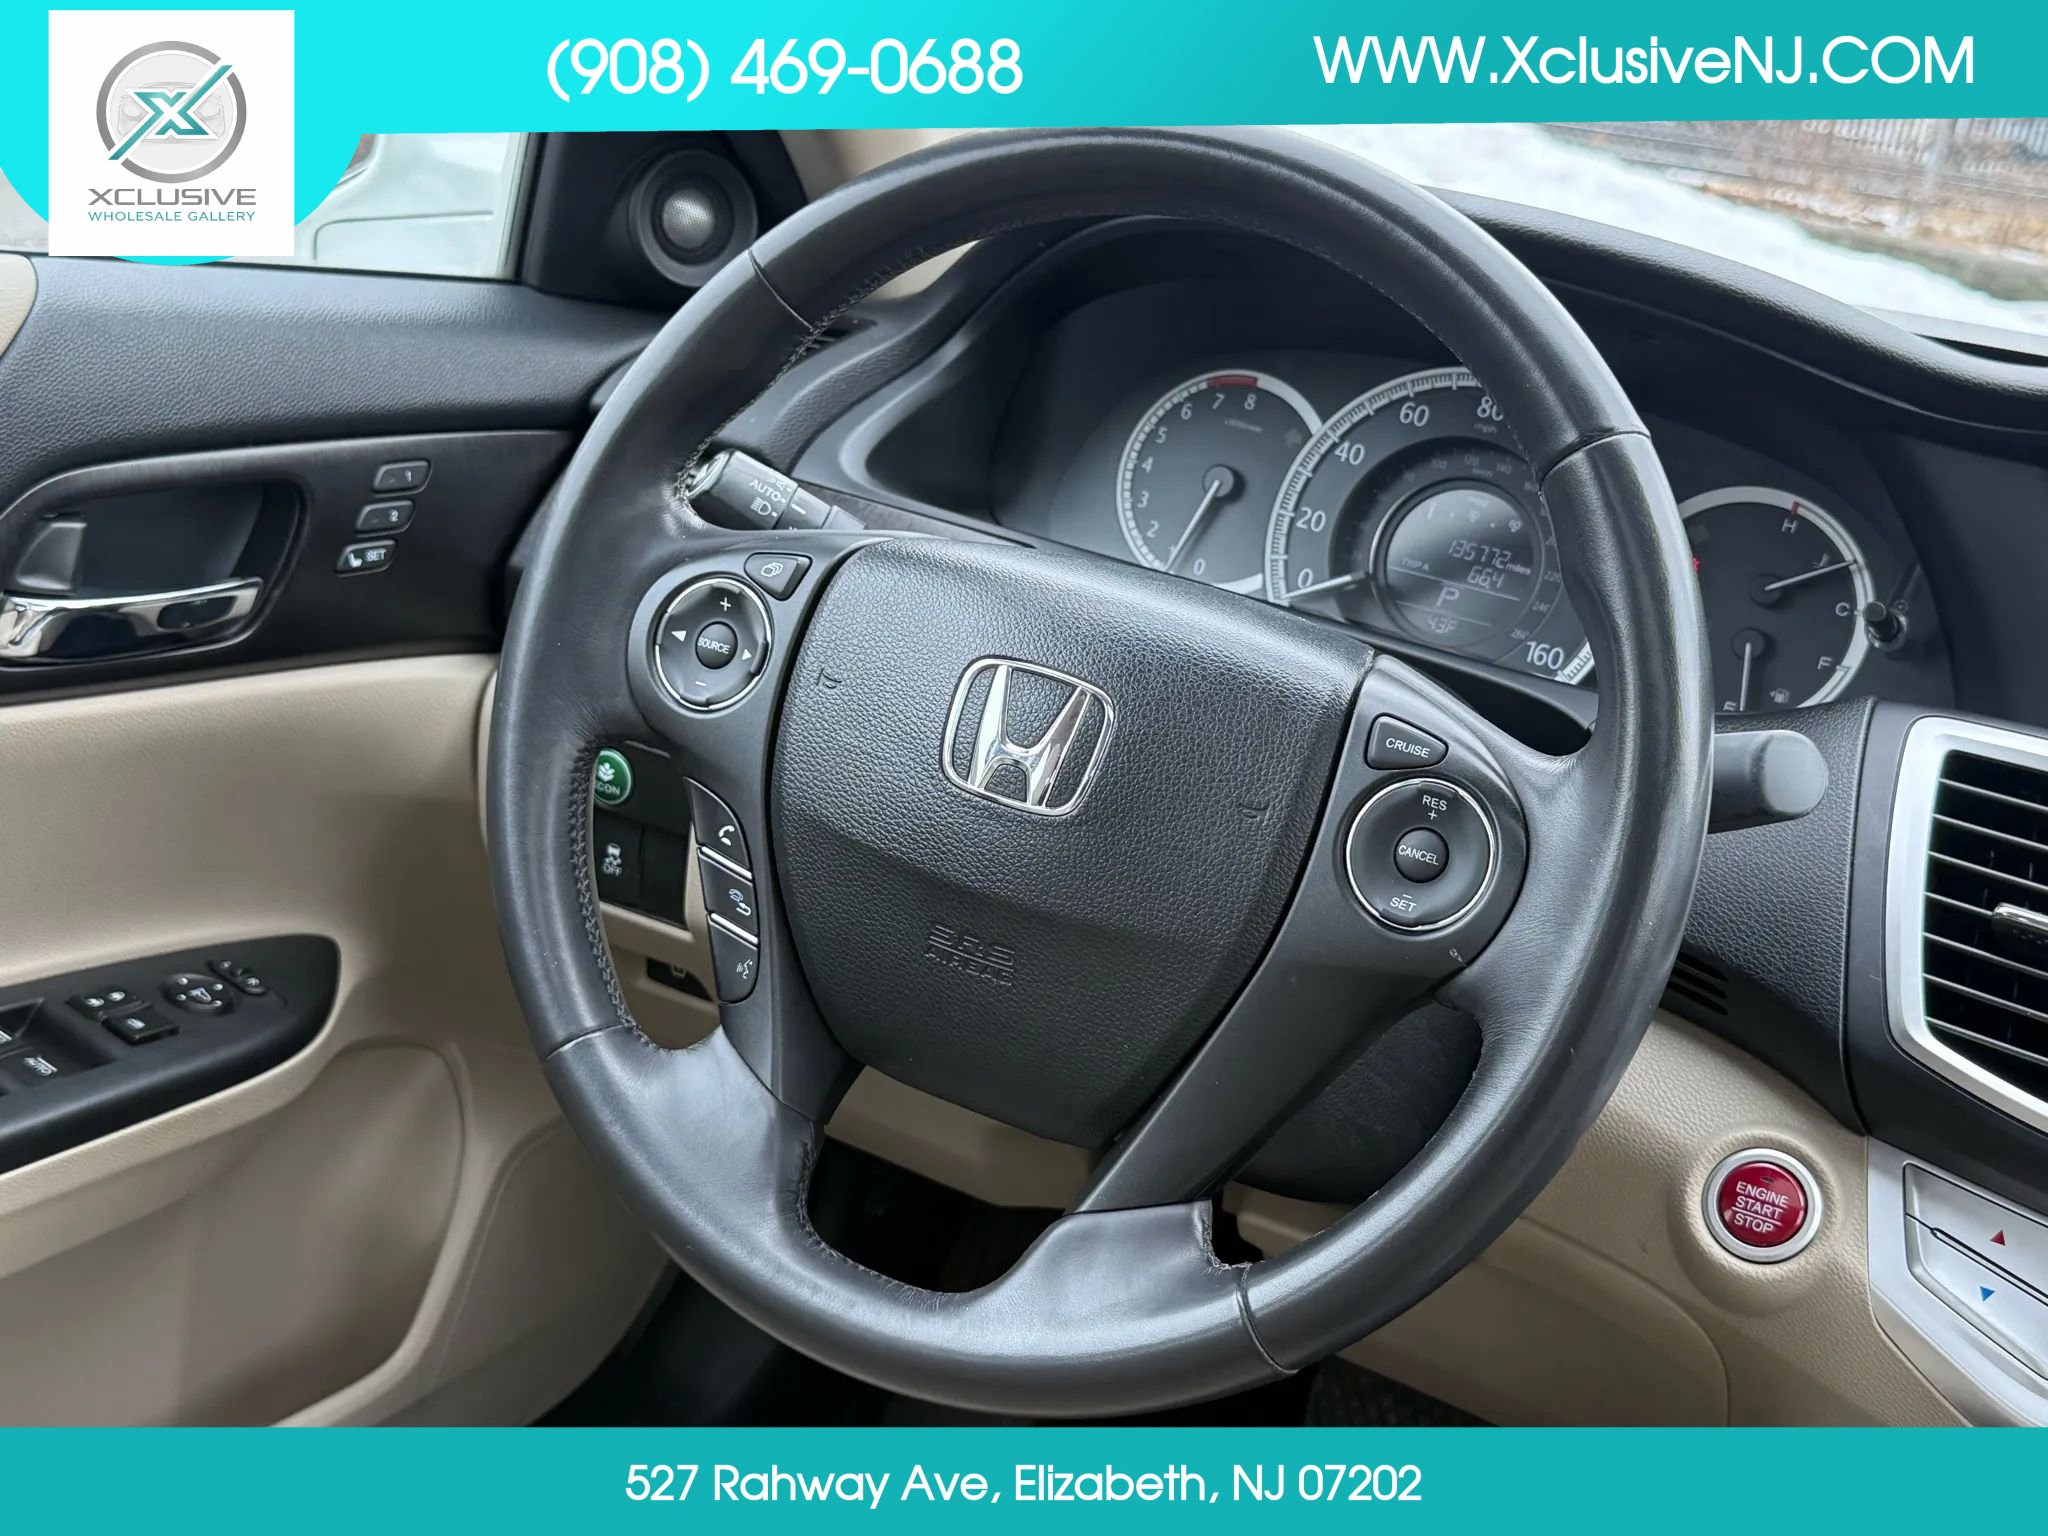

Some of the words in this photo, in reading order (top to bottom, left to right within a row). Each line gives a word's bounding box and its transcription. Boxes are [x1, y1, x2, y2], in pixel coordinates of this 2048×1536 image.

[1212, 393, 1225, 410] 7
[1244, 393, 1257, 411] 8
[1180, 403, 1193, 420] 6
[1399, 401, 1430, 428] 60
[1155, 427, 1168, 444] 5
[1334, 441, 1365, 466] 40
[1141, 456, 1154, 473] 4
[405, 469, 412, 482] 1
[749, 479, 781, 501] AUTO
[1137, 491, 1150, 508] 3
[1295, 507, 1326, 533] 20
[1781, 518, 1799, 534] H
[1146, 520, 1160, 538] 2
[364, 547, 387, 562] SET
[1448, 539, 1512, 569] 135772
[1193, 559, 1206, 576] 0
[1505, 562, 1532, 576] miles
[1297, 568, 1314, 589] 0
[1436, 586, 1460, 607] P
[1835, 602, 1850, 616] C
[697, 636, 731, 655] SOURCE
[1525, 640, 1565, 670] 160
[1817, 656, 1833, 670] F
[1385, 737, 1431, 759] CRUISE
[595, 780, 621, 796] CON
[1422, 794, 1448, 811] RES
[1398, 844, 1440, 866] CANCEL
[602, 863, 623, 877] OFF
[1390, 896, 1417, 912] SET
[1736, 1181, 1789, 1208] ENGINE
[1736, 1195, 1783, 1219] START
[1734, 1214, 1774, 1233] STOP
